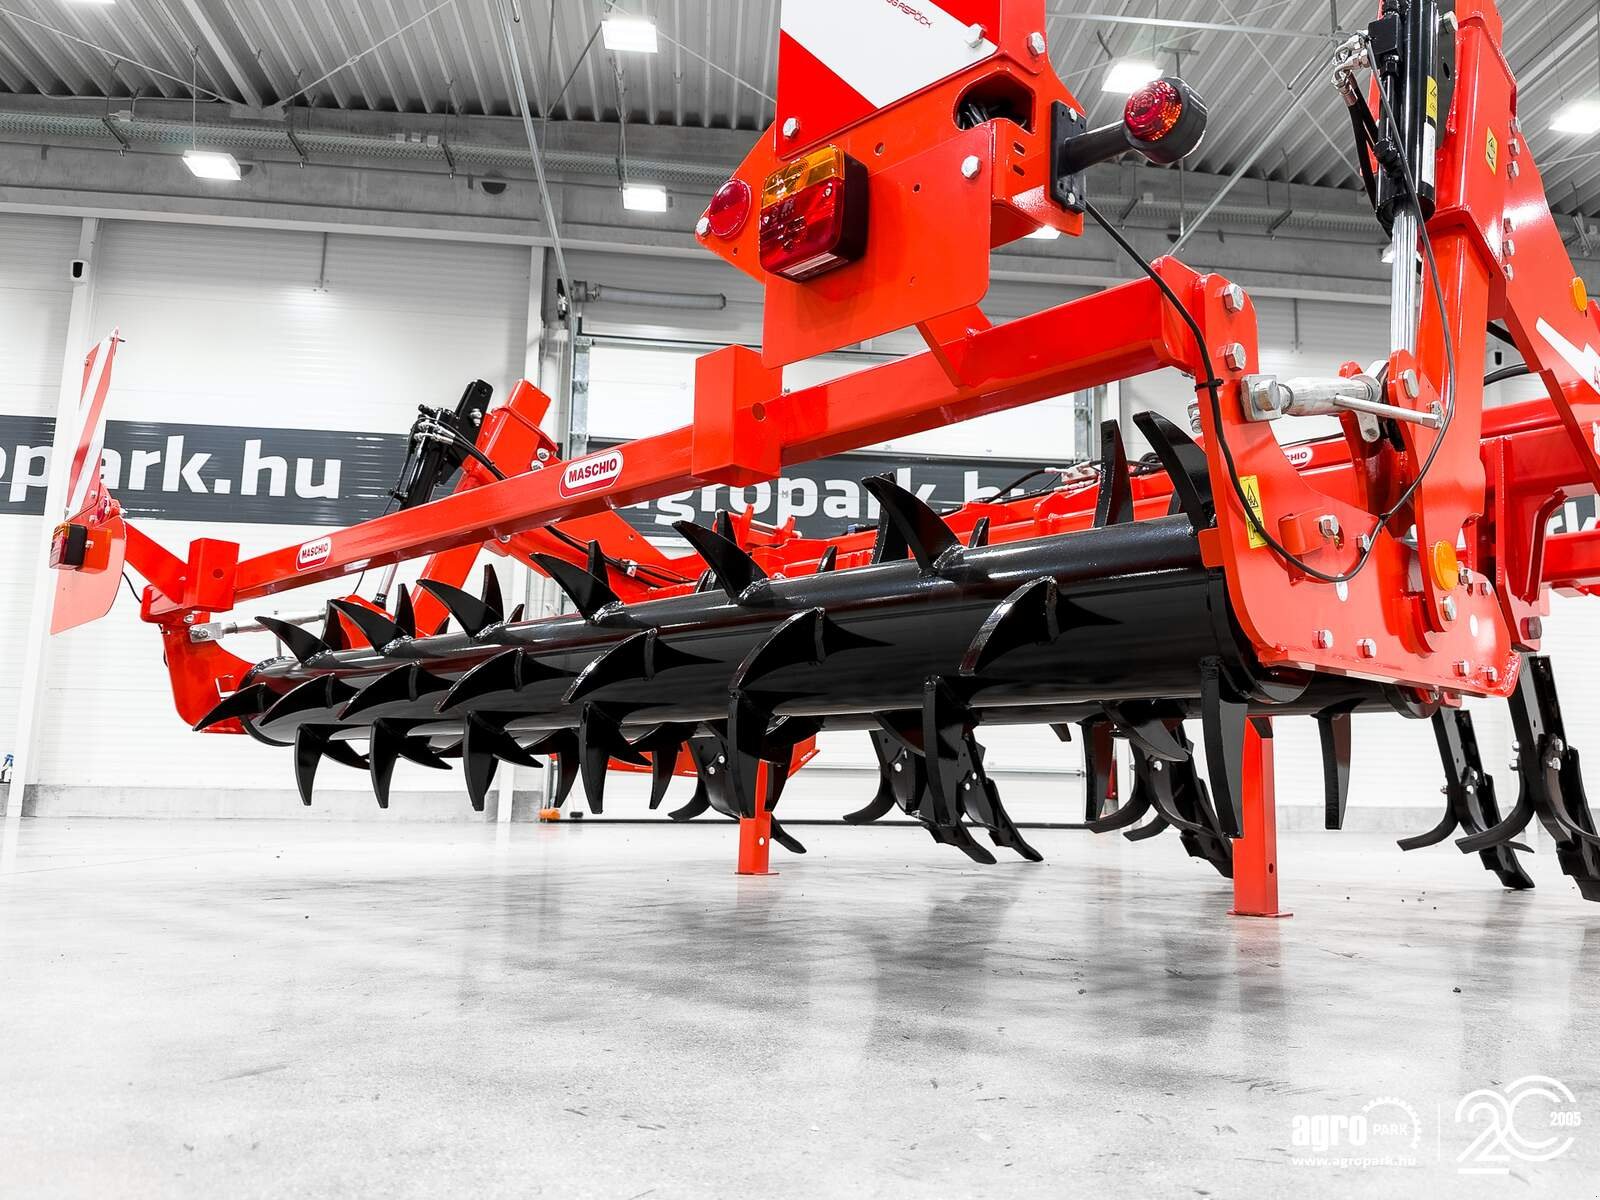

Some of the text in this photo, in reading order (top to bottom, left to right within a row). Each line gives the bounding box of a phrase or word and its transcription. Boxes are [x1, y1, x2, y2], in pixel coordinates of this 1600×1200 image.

[0, 435, 342, 502] park.hu
[568, 458, 617, 483] MASCHIO
[302, 543, 328, 559] MASCHIO
